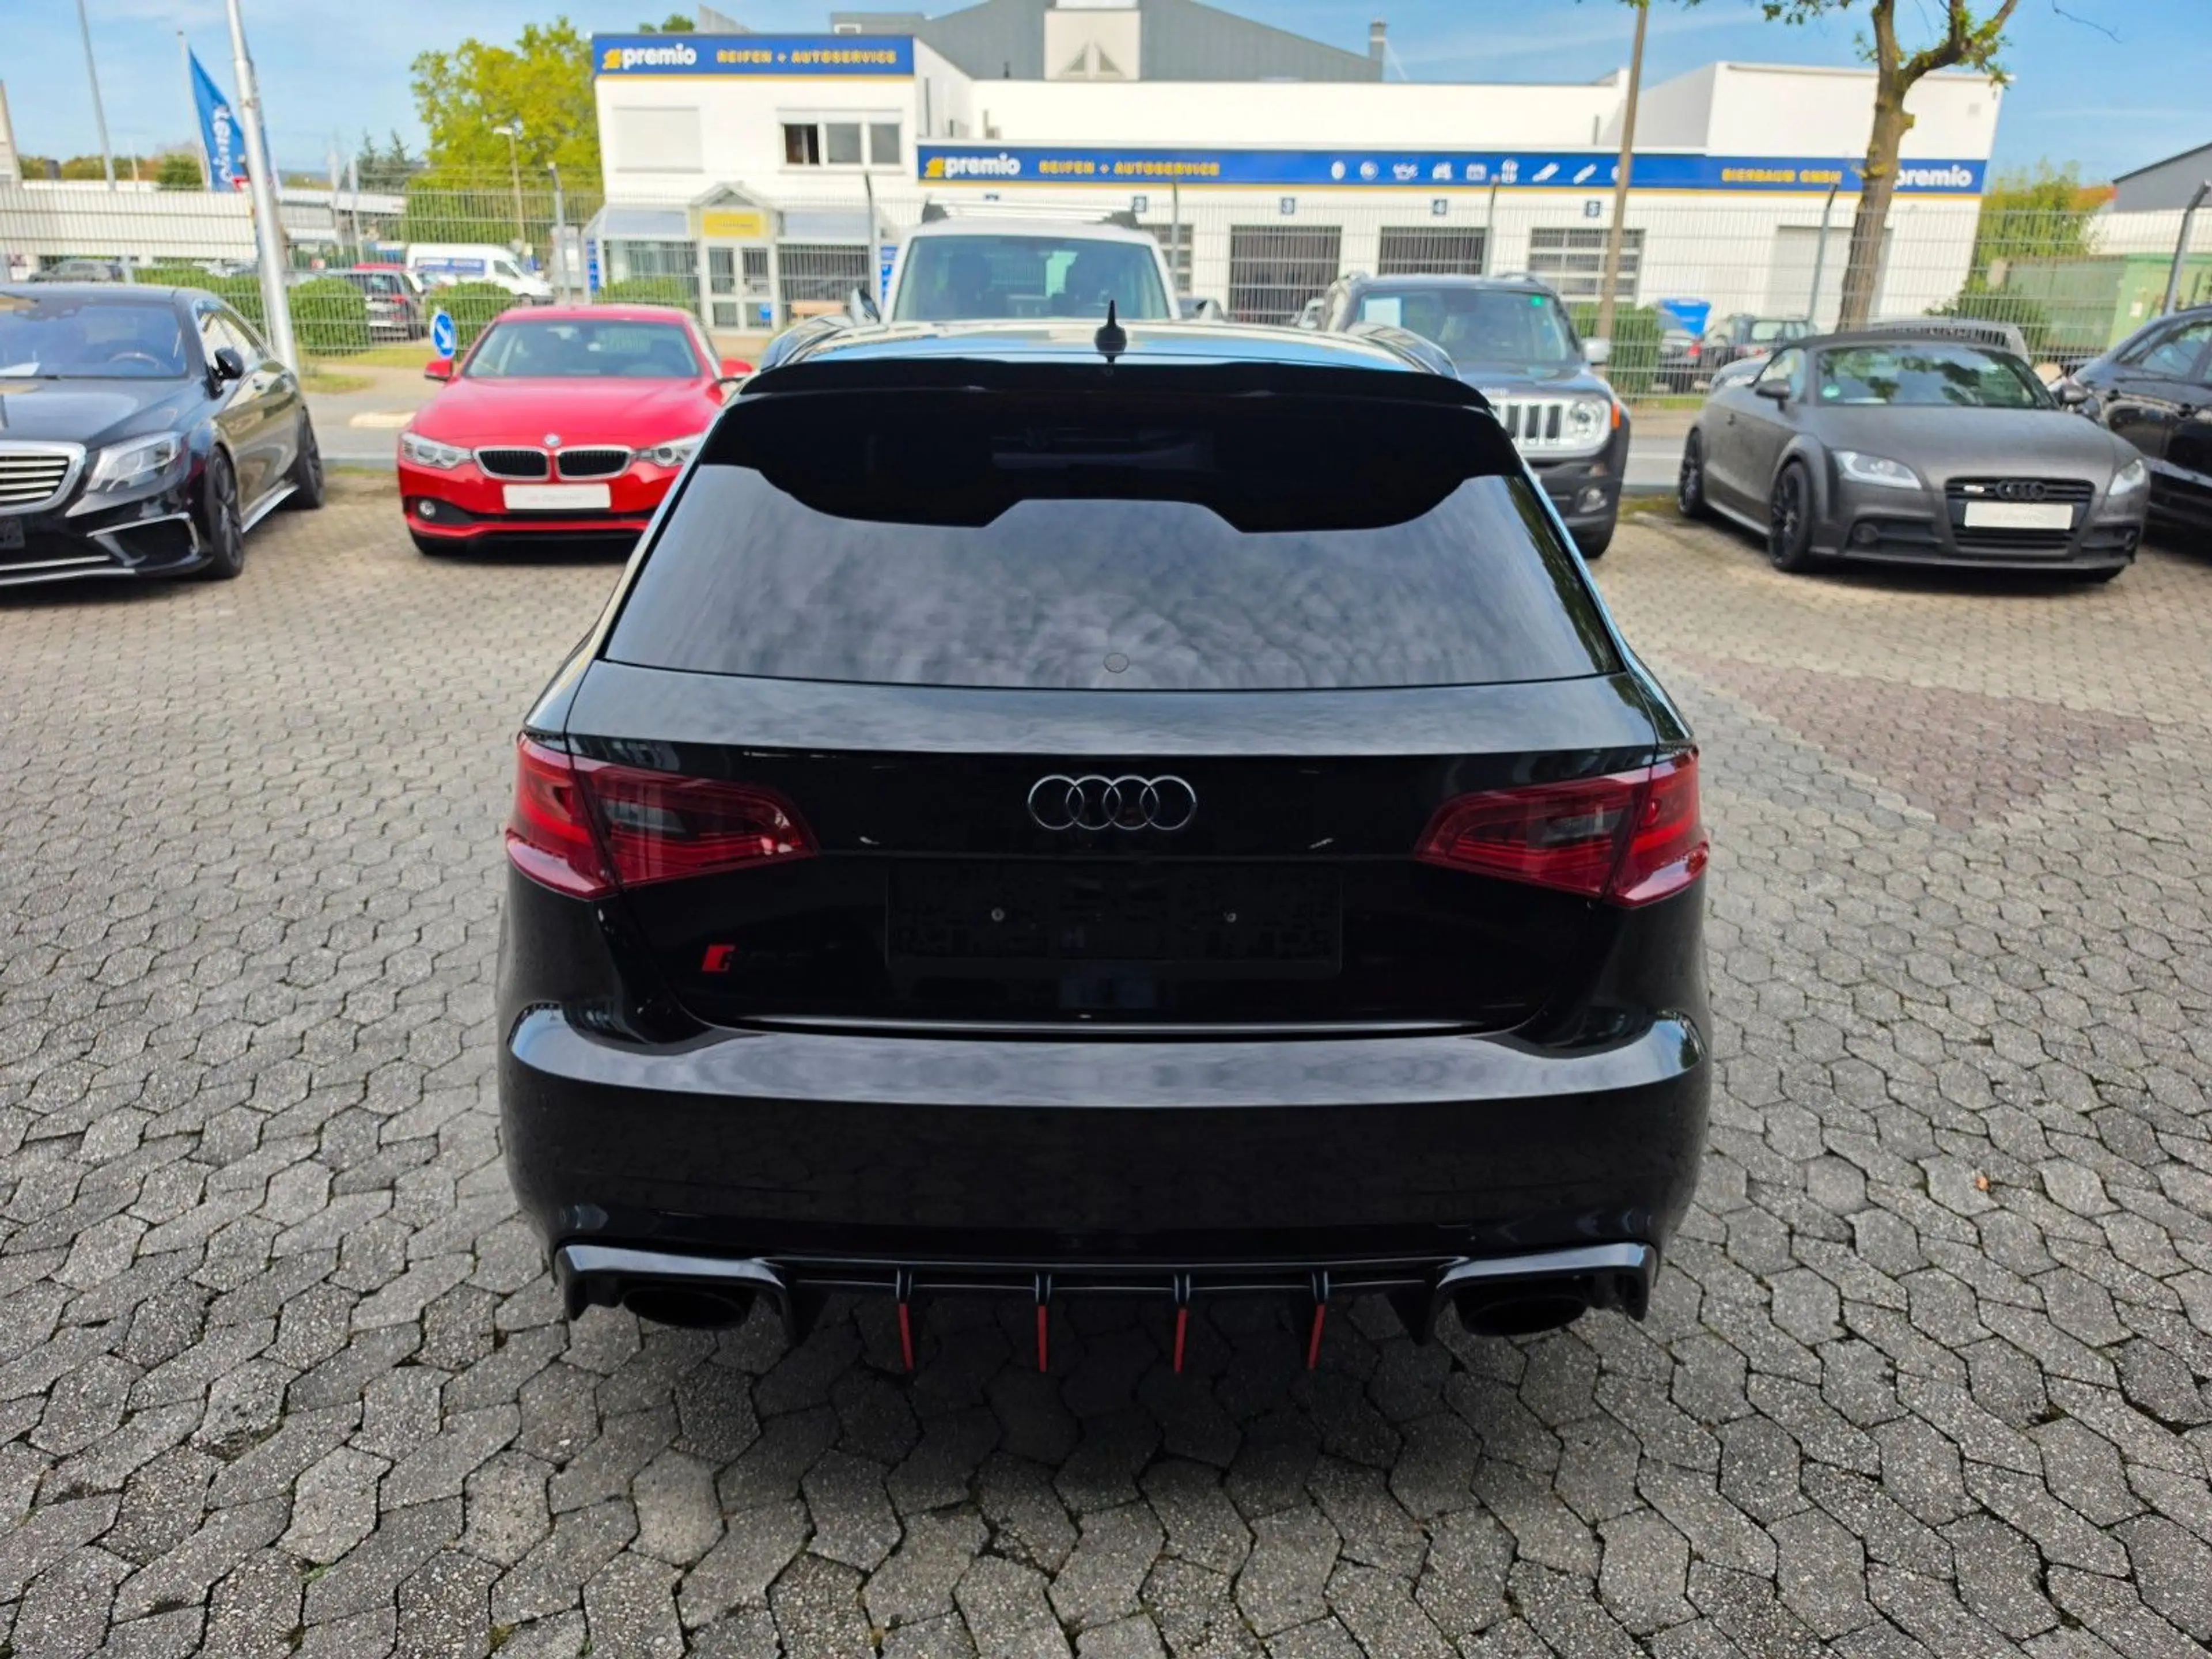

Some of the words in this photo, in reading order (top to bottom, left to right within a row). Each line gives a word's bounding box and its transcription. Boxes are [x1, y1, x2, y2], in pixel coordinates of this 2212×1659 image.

[622, 43, 696, 70] premio
[717, 49, 772, 63] REIFEN
[791, 50, 897, 63] AUTOSERVICE
[945, 152, 1021, 179] premio
[1039, 160, 1094, 175] REIFEN
[1114, 161, 1220, 176] AUTOSERVICE
